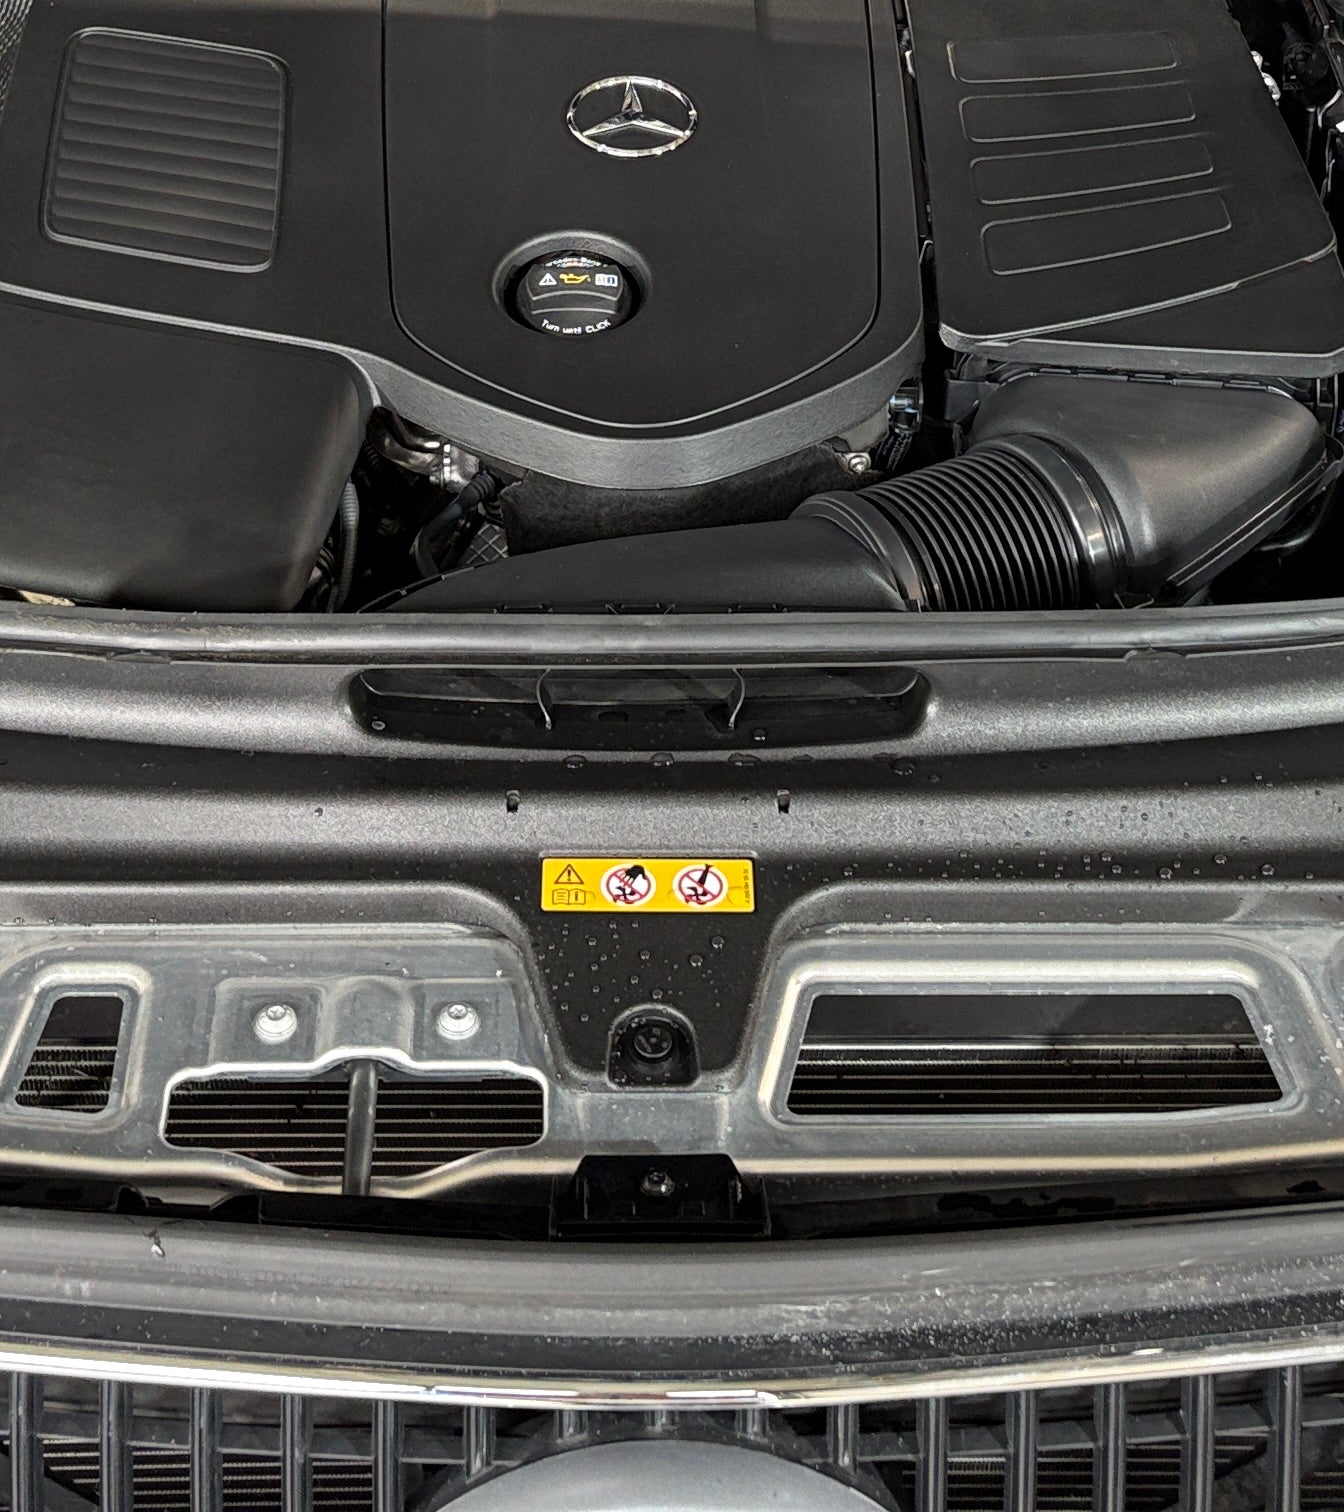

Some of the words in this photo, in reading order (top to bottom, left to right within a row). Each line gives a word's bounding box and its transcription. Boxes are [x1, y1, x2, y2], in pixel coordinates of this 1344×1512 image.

[541, 319, 560, 333] Turn
[562, 326, 582, 335] until
[585, 318, 612, 334] CLICK
